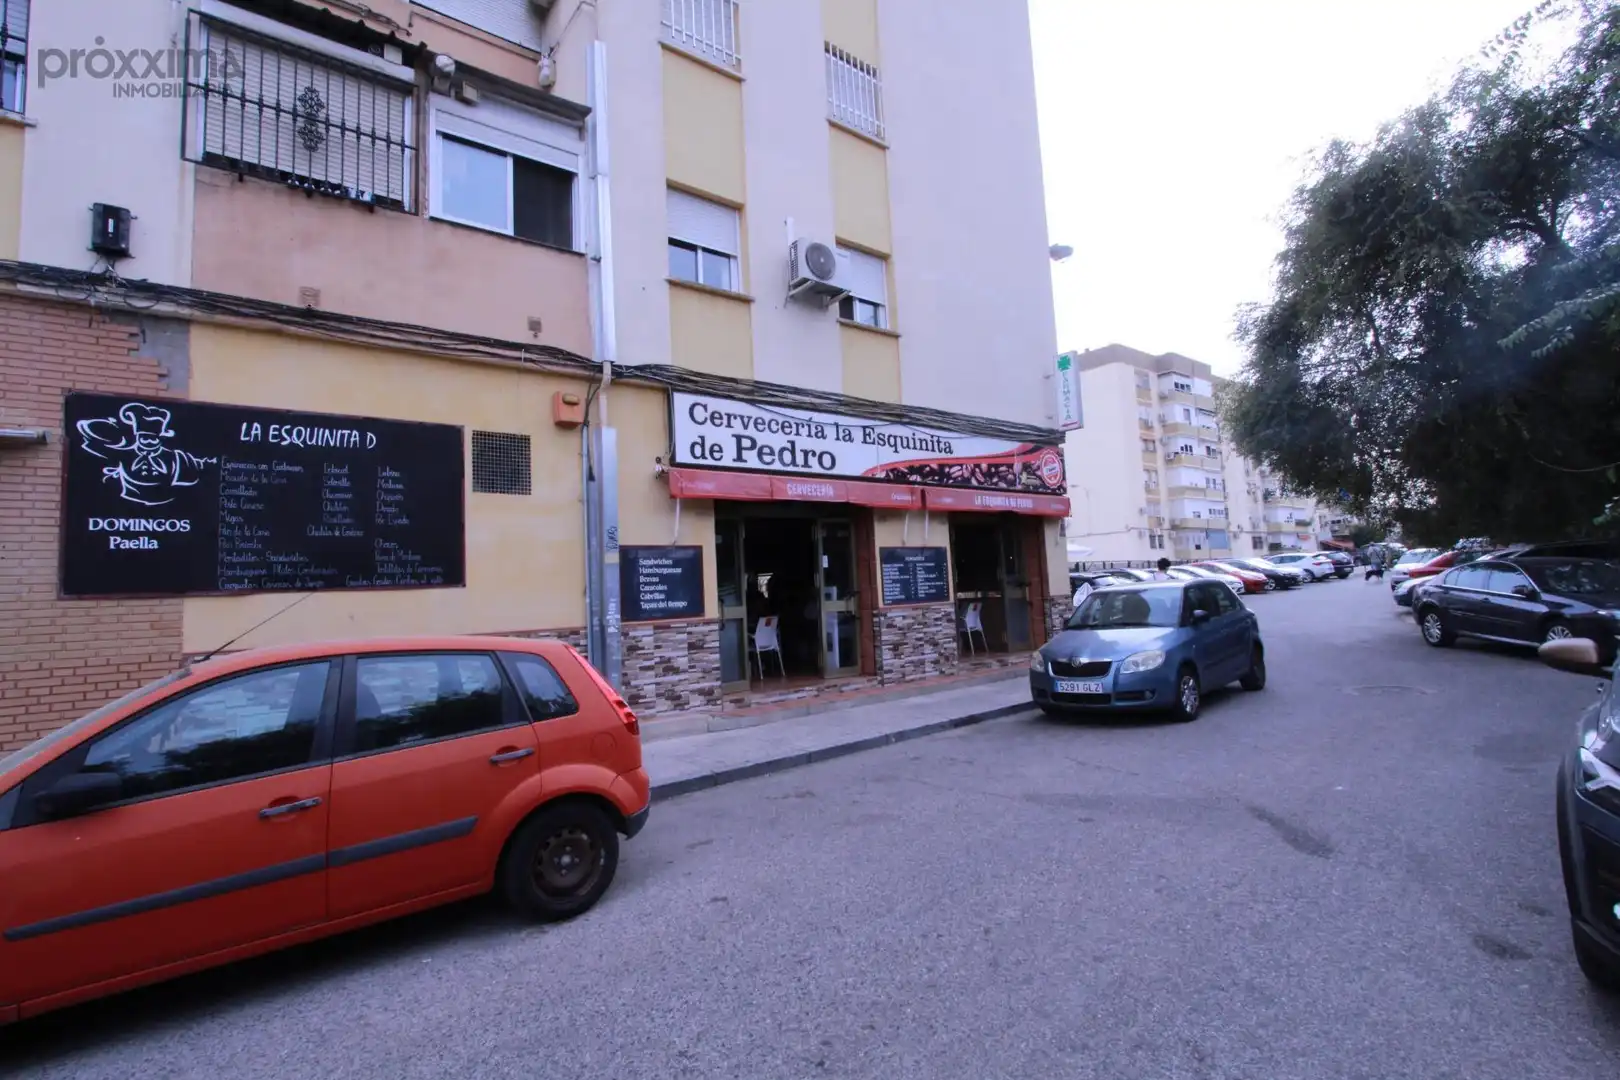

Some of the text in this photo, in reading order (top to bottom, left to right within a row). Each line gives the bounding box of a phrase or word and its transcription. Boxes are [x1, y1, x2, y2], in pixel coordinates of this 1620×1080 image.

[240, 422, 377, 449] LA ESQUINITA D
[688, 401, 954, 455] Cervecería la Esquinita
[690, 434, 836, 472] de Pedro
[88, 517, 191, 532] DOMINGOS
[109, 536, 158, 550] Paella
[1059, 683, 1101, 692] 5291 GLZ
